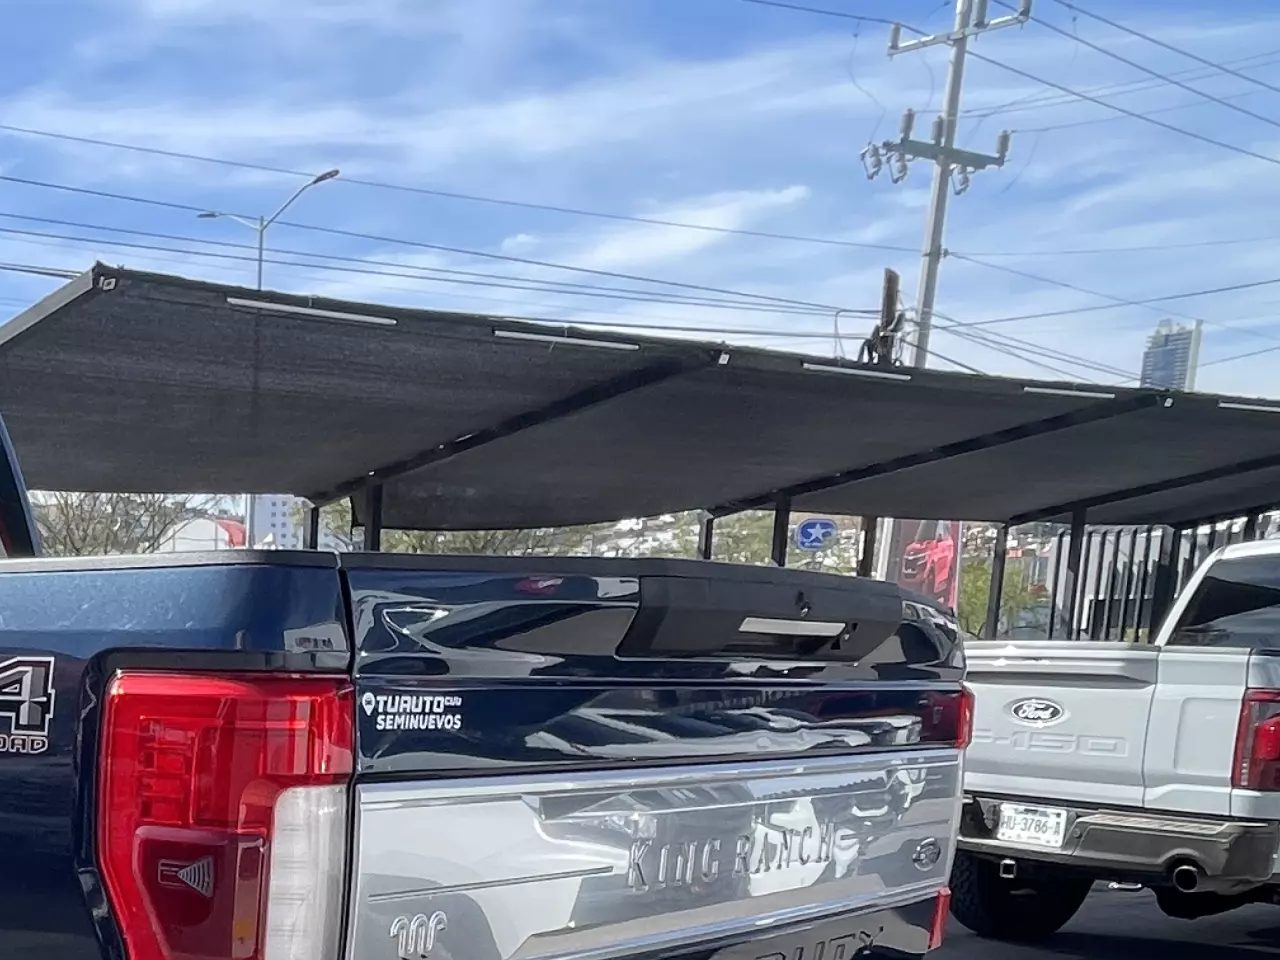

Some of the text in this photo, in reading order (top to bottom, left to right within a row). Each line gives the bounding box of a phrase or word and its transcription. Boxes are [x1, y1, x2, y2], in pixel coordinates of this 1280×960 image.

[1018, 702, 1056, 720] Ford
[375, 714, 462, 731] SEMINUEVOS
[628, 819, 837, 893] KING RANCH
